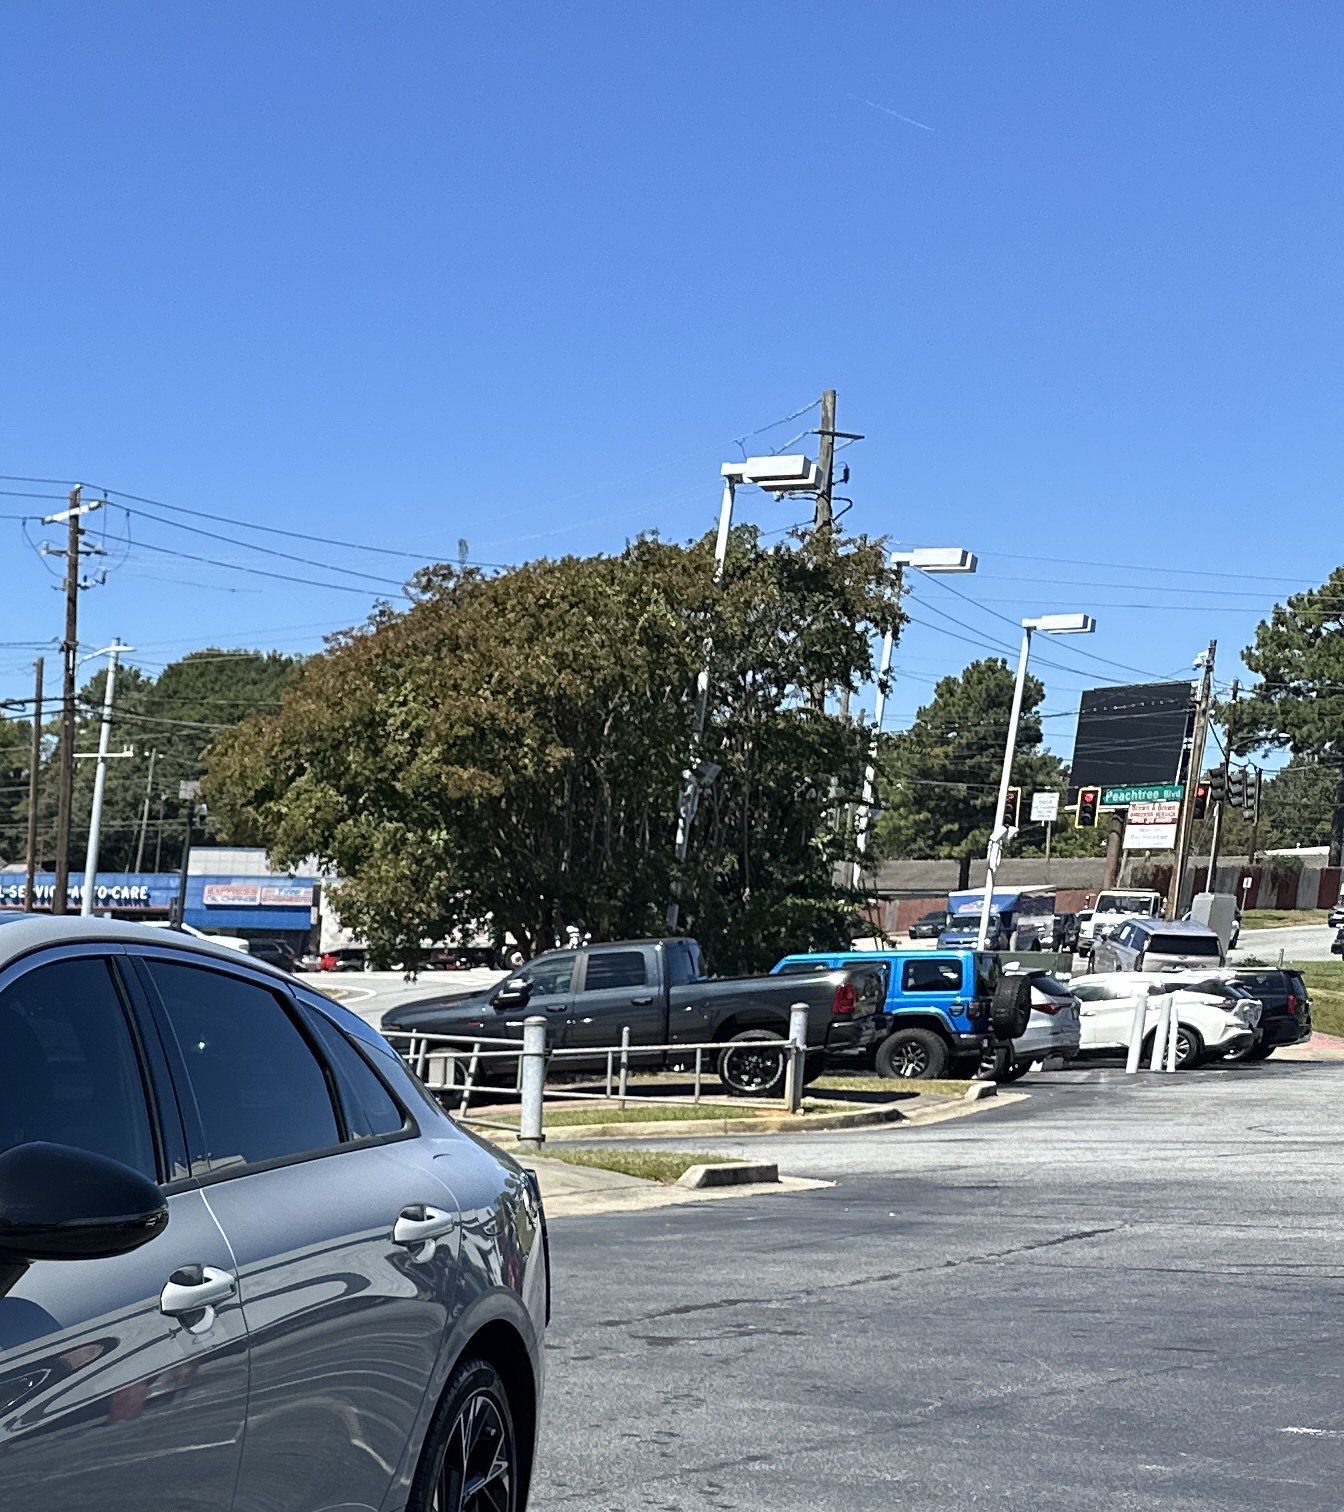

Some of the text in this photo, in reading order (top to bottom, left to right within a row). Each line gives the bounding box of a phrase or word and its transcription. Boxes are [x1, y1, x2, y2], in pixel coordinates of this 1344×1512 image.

[1105, 789, 1181, 802] Peachtree Blvd
[112, 885, 149, 900] CARE
